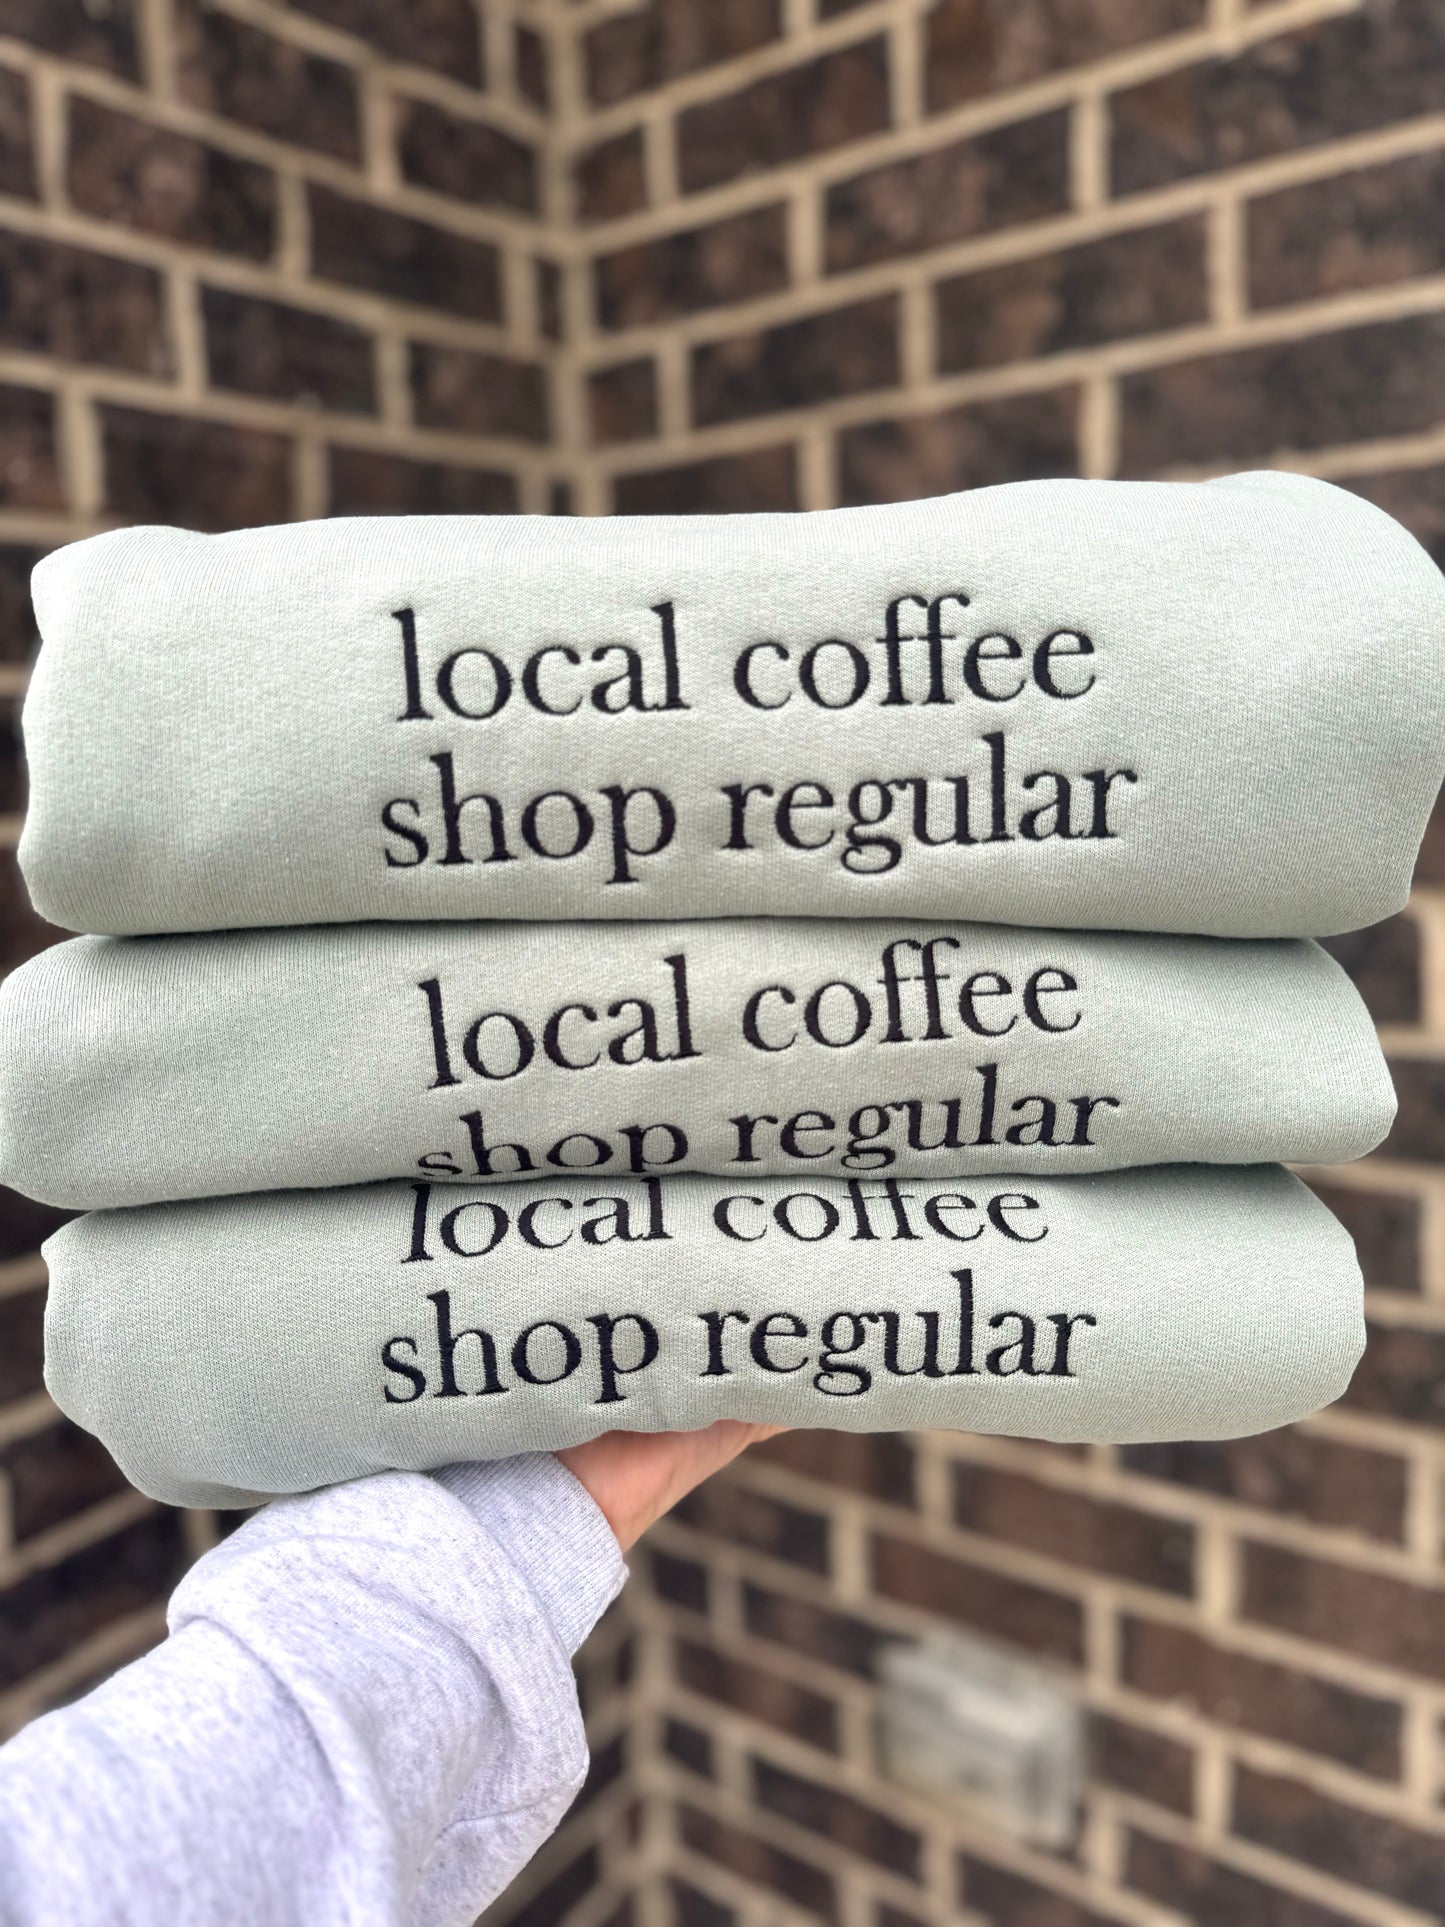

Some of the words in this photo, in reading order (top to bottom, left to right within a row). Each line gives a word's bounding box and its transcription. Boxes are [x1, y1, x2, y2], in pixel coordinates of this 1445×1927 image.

[391, 602, 690, 722] local
[733, 594, 1096, 710] coffee
[381, 752, 677, 884] shop
[720, 732, 1138, 875] regular
[418, 954, 703, 1090] local
[742, 936, 1082, 1052] coffee
[418, 1111, 689, 1176] shop
[728, 1063, 1121, 1170] regular
[401, 1177, 673, 1264] local
[381, 1290, 660, 1404] shop
[697, 1269, 1097, 1397] regular
